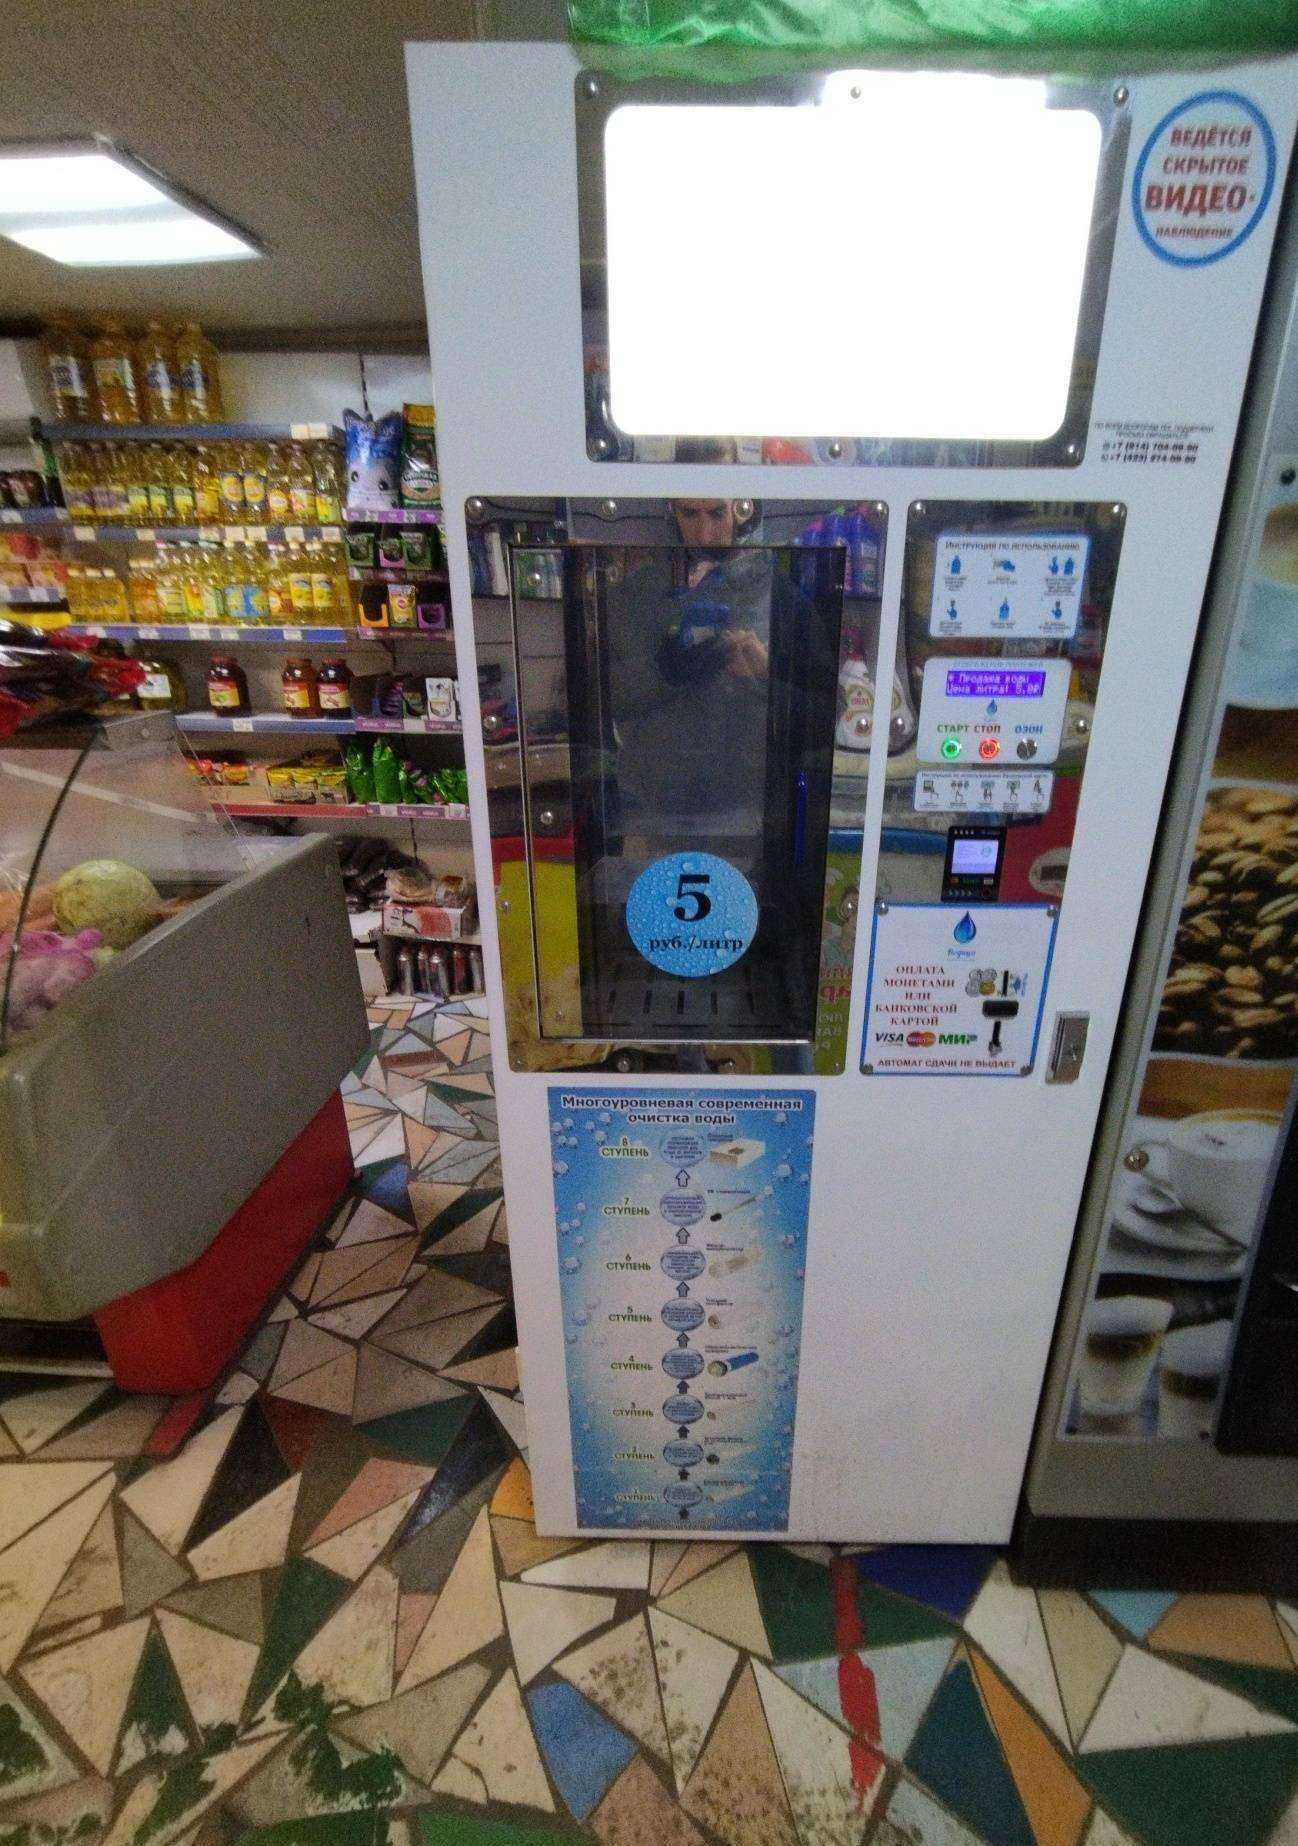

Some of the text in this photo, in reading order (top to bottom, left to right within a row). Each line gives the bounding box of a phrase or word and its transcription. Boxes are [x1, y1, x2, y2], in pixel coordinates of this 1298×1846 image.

[1170, 125, 1252, 149] ВЕДЁТСЯ
[1163, 157, 1249, 174] СКРЫТОЕ
[1155, 226, 1233, 239] НАБЛЮДЕНИЕ
[937, 724, 1044, 734] СТАРТ СТОП ОЗОН
[674, 874, 712, 922] 5
[896, 965, 945, 975] ОПЛАТА
[884, 978, 955, 988] МОНЕТАМИ
[905, 992, 931, 1000] ИЛИ
[876, 1003, 957, 1014] БАНКОВСКОЙ
[890, 1016, 938, 1026] КАРТОЙ
[875, 1033, 904, 1043] VISA
[878, 1060, 923, 1068] АВТОМАТ
[925, 1060, 957, 1069] СДАЧИ
[563, 1096, 802, 1112] Многоуровневая современная
[628, 1114, 735, 1125] очистка воды
[601, 1147, 649, 1157] СТУПЕНЬ
[604, 1206, 650, 1216] СТУПЕНЬ
[606, 1262, 651, 1271] СТУПЕНЬ
[608, 1314, 652, 1322] СТУПЕНЬ
[611, 1362, 653, 1371] СТУПЕНЬ
